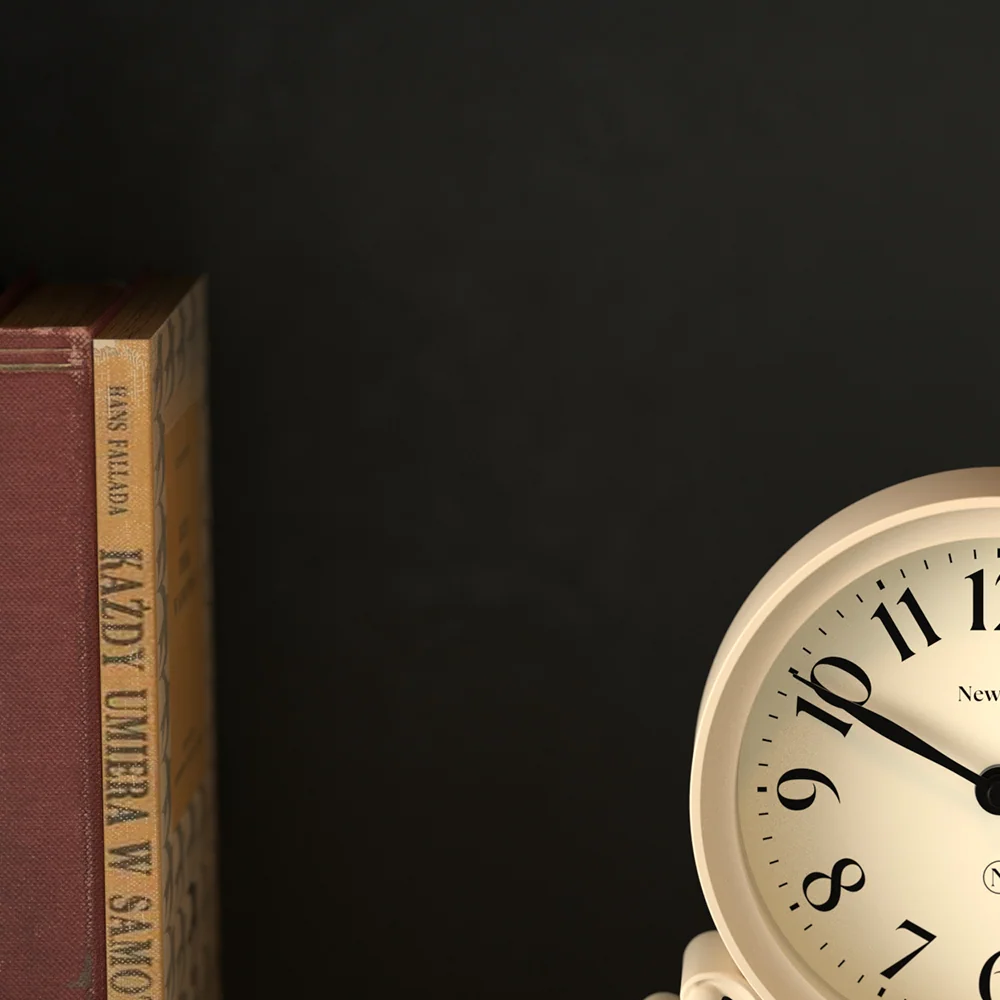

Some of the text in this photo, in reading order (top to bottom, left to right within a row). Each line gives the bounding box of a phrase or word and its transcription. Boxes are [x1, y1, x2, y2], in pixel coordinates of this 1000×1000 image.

[107, 386, 129, 516] HANS FALLADA
[99, 548, 151, 671] KAŻDY
[870, 587, 942, 662] 11
[796, 656, 872, 738] 10
[104, 688, 149, 825] UMIERA
[776, 767, 841, 812] 9
[108, 840, 152, 875] W
[802, 857, 867, 913] 8
[879, 919, 937, 980] 7
